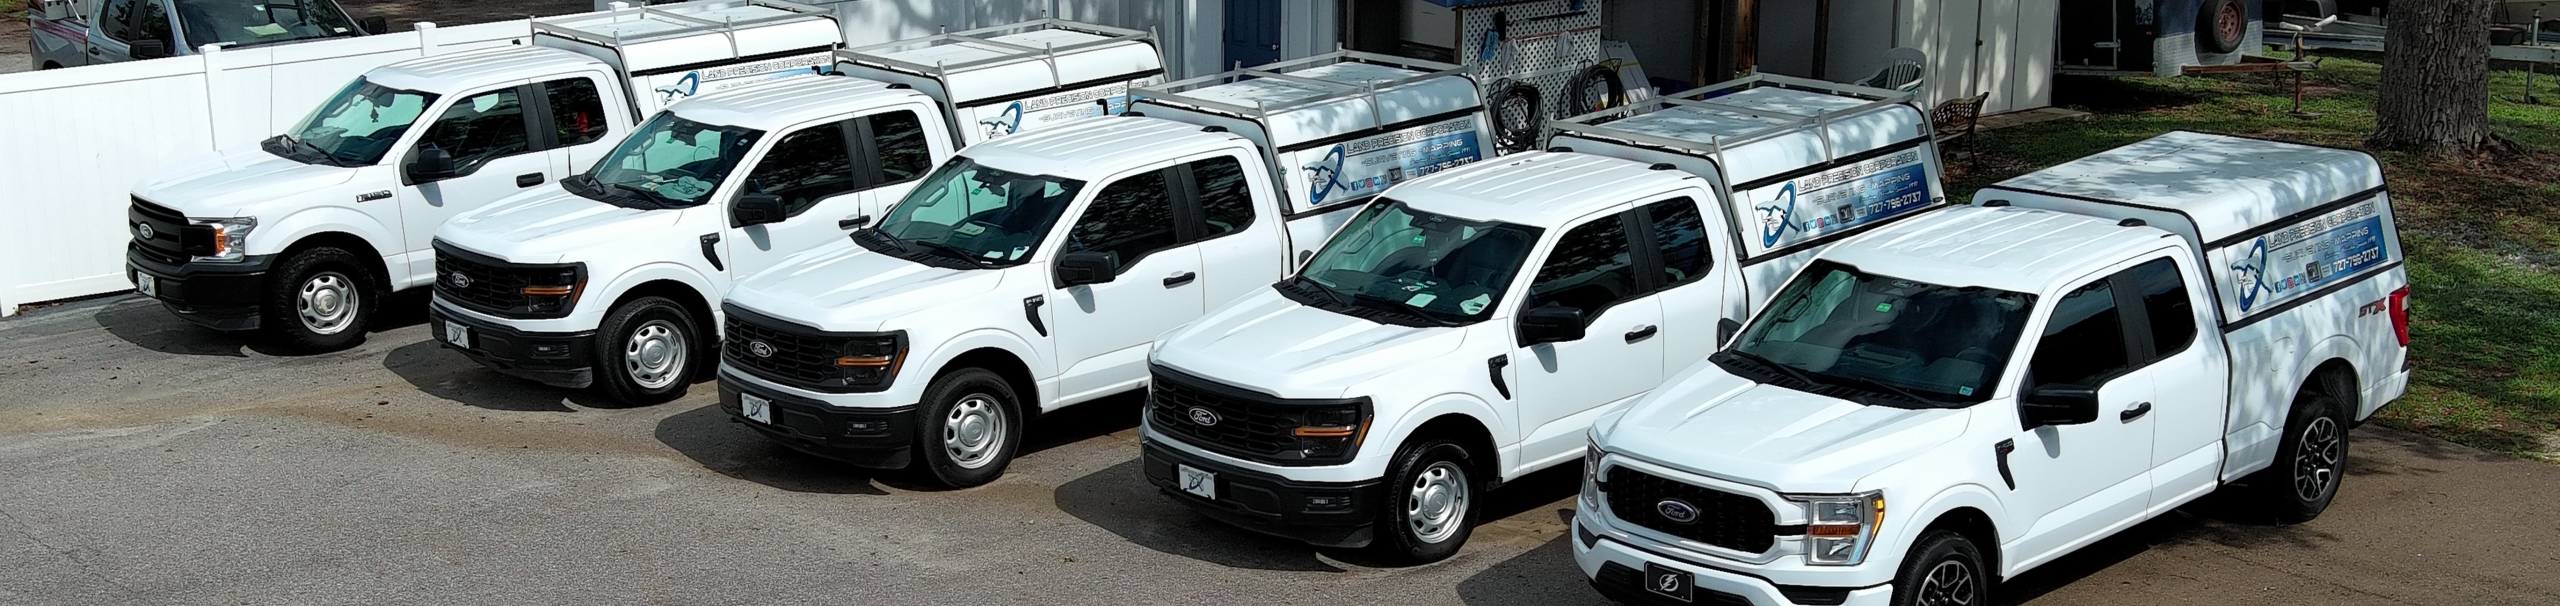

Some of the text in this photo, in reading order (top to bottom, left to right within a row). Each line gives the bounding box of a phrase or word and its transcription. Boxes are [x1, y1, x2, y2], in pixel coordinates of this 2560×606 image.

[1024, 97, 1049, 110] LAND
[1346, 119, 1471, 154] LAND PRECISION CORPORATION
[1798, 151, 1918, 192] LAND PRECISION CORPORATION
[2268, 202, 2376, 248] LAND PRECISION CORPORATION
